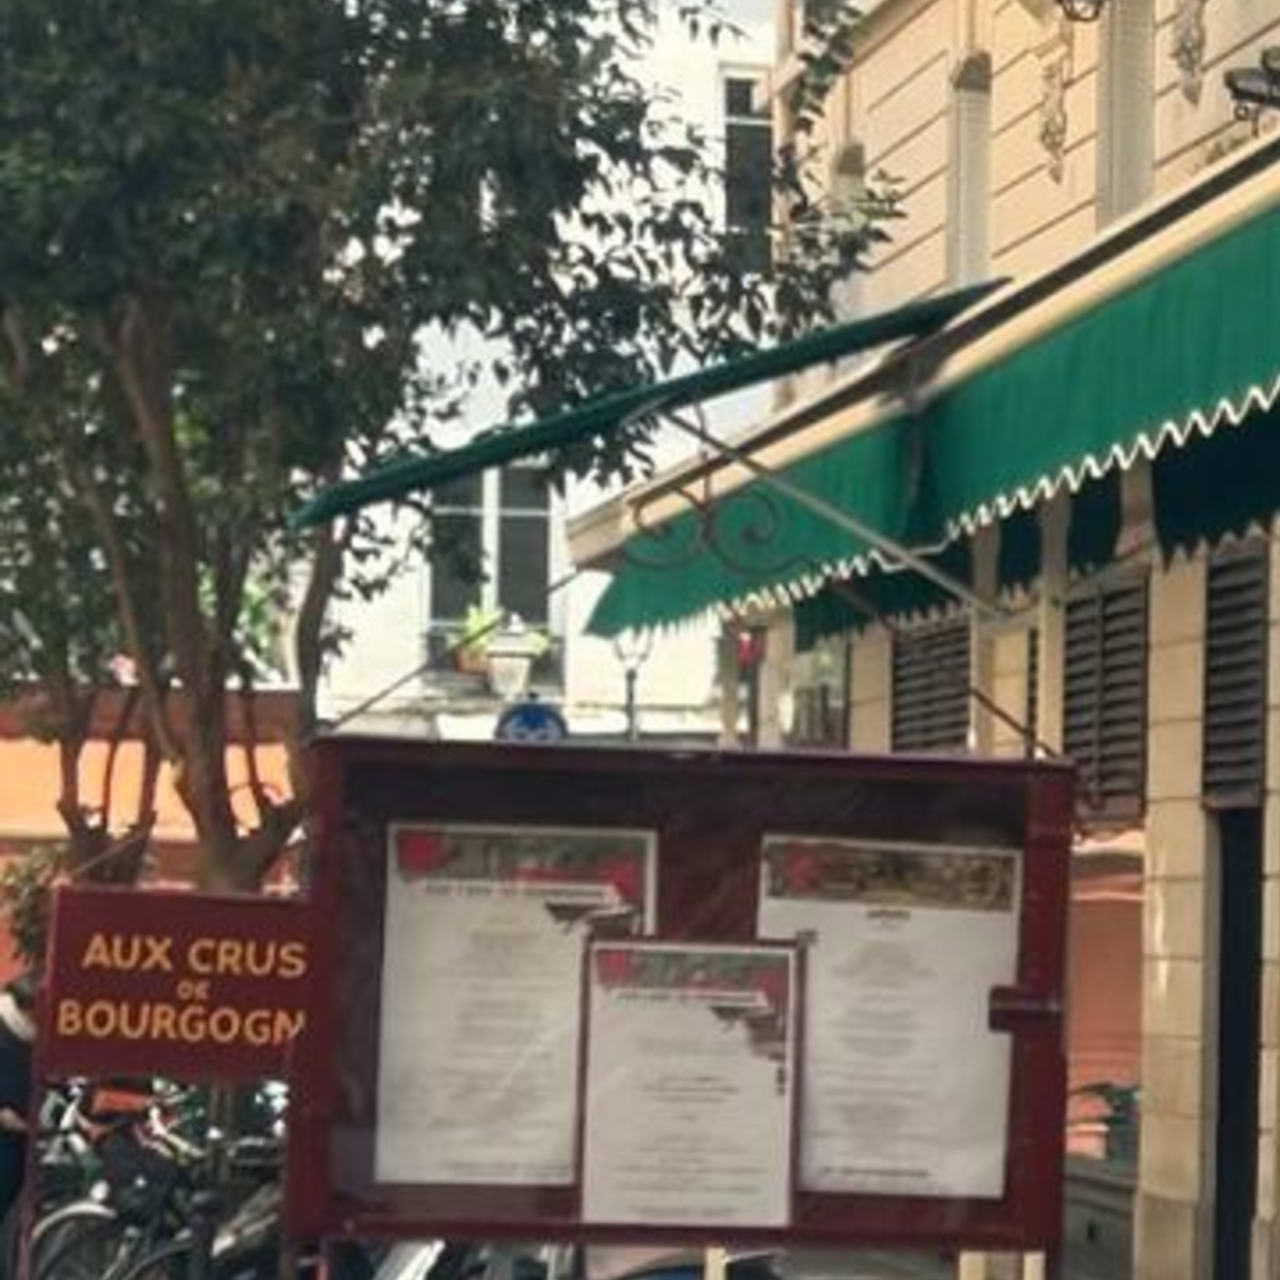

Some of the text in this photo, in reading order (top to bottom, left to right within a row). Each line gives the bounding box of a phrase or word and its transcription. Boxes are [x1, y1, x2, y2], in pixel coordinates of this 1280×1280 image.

[82, 933, 308, 978] AUX CRUS
[176, 979, 211, 1001] DE
